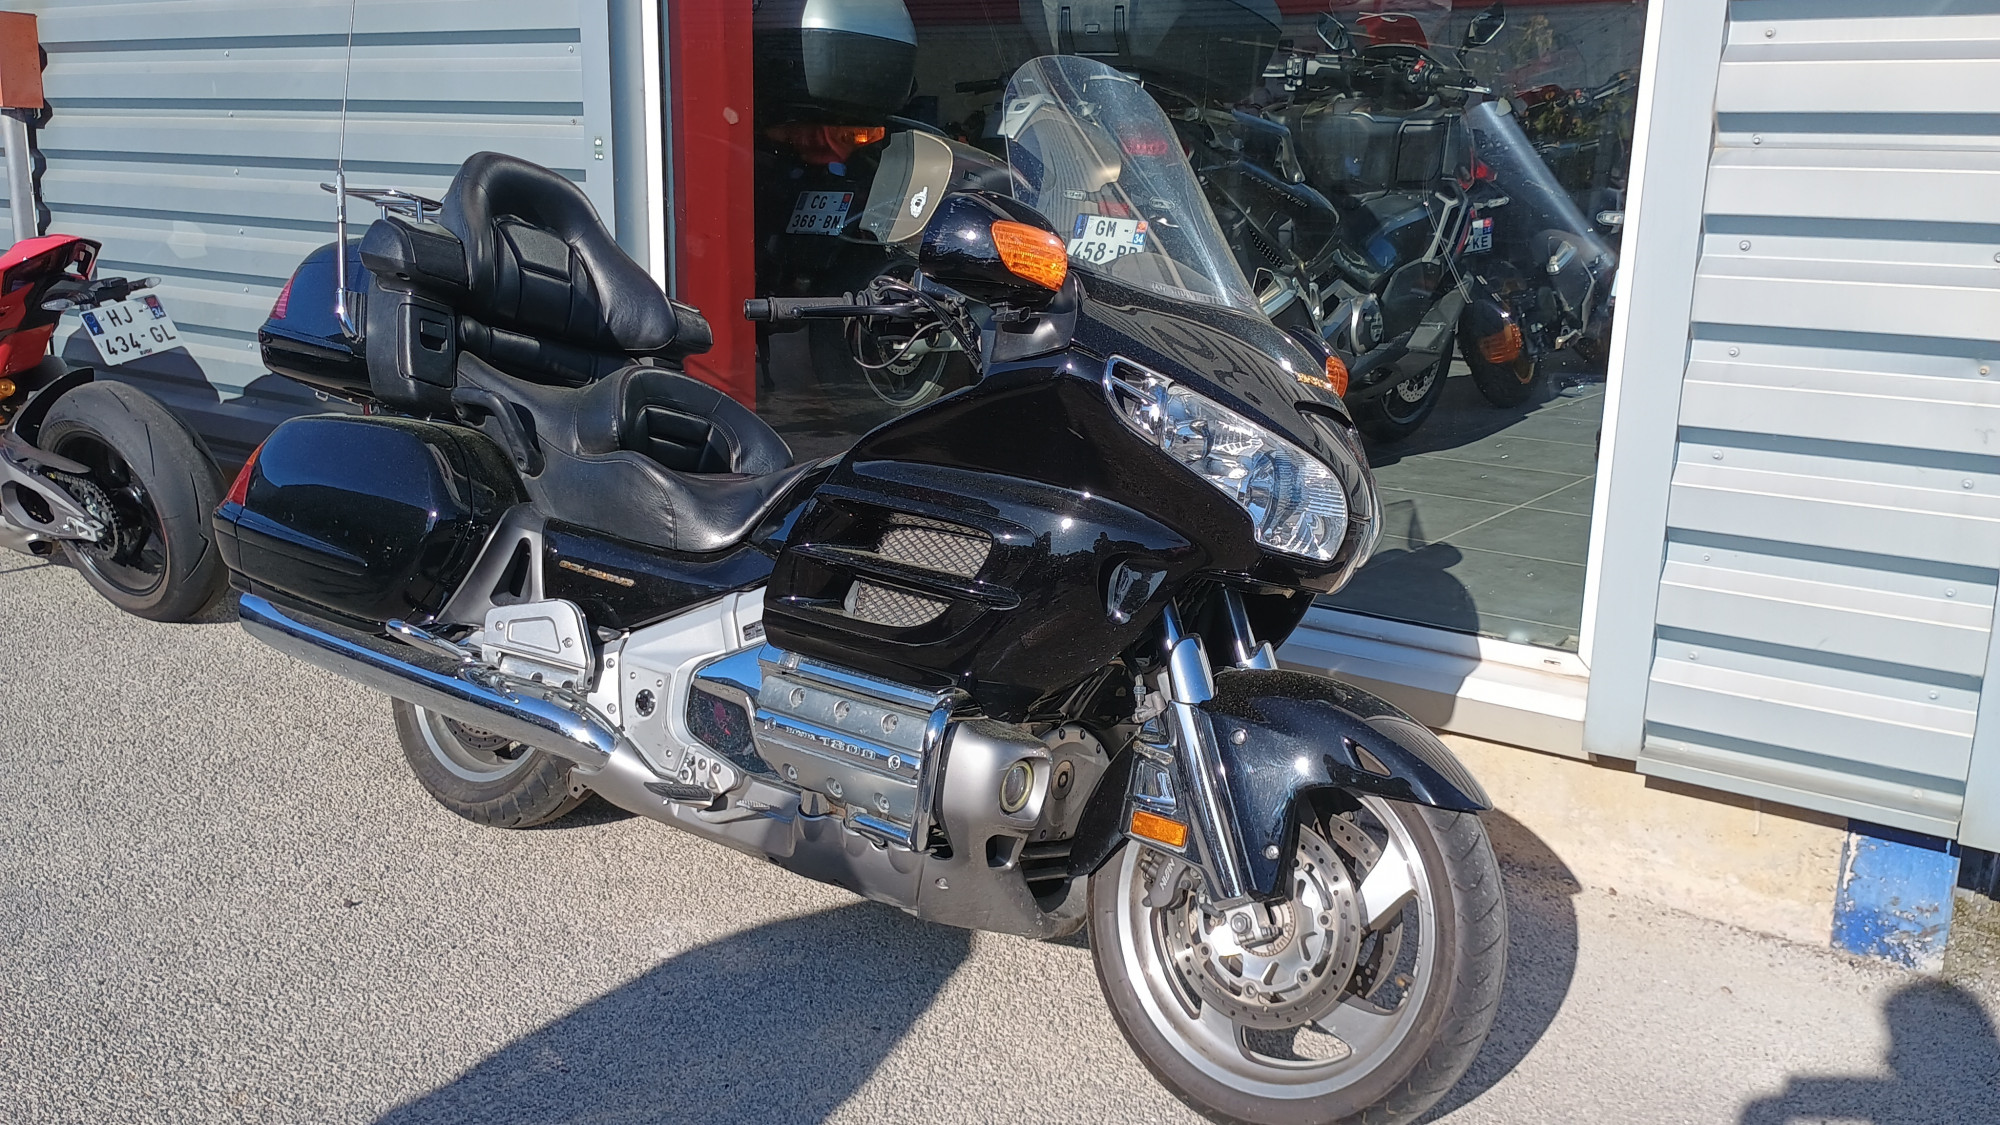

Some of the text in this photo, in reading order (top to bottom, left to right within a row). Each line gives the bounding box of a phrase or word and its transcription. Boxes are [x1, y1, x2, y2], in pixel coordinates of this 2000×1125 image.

[1133, 233, 1144, 244] 34
[105, 325, 176, 355] 434-GL
[819, 735, 876, 760] 1800
